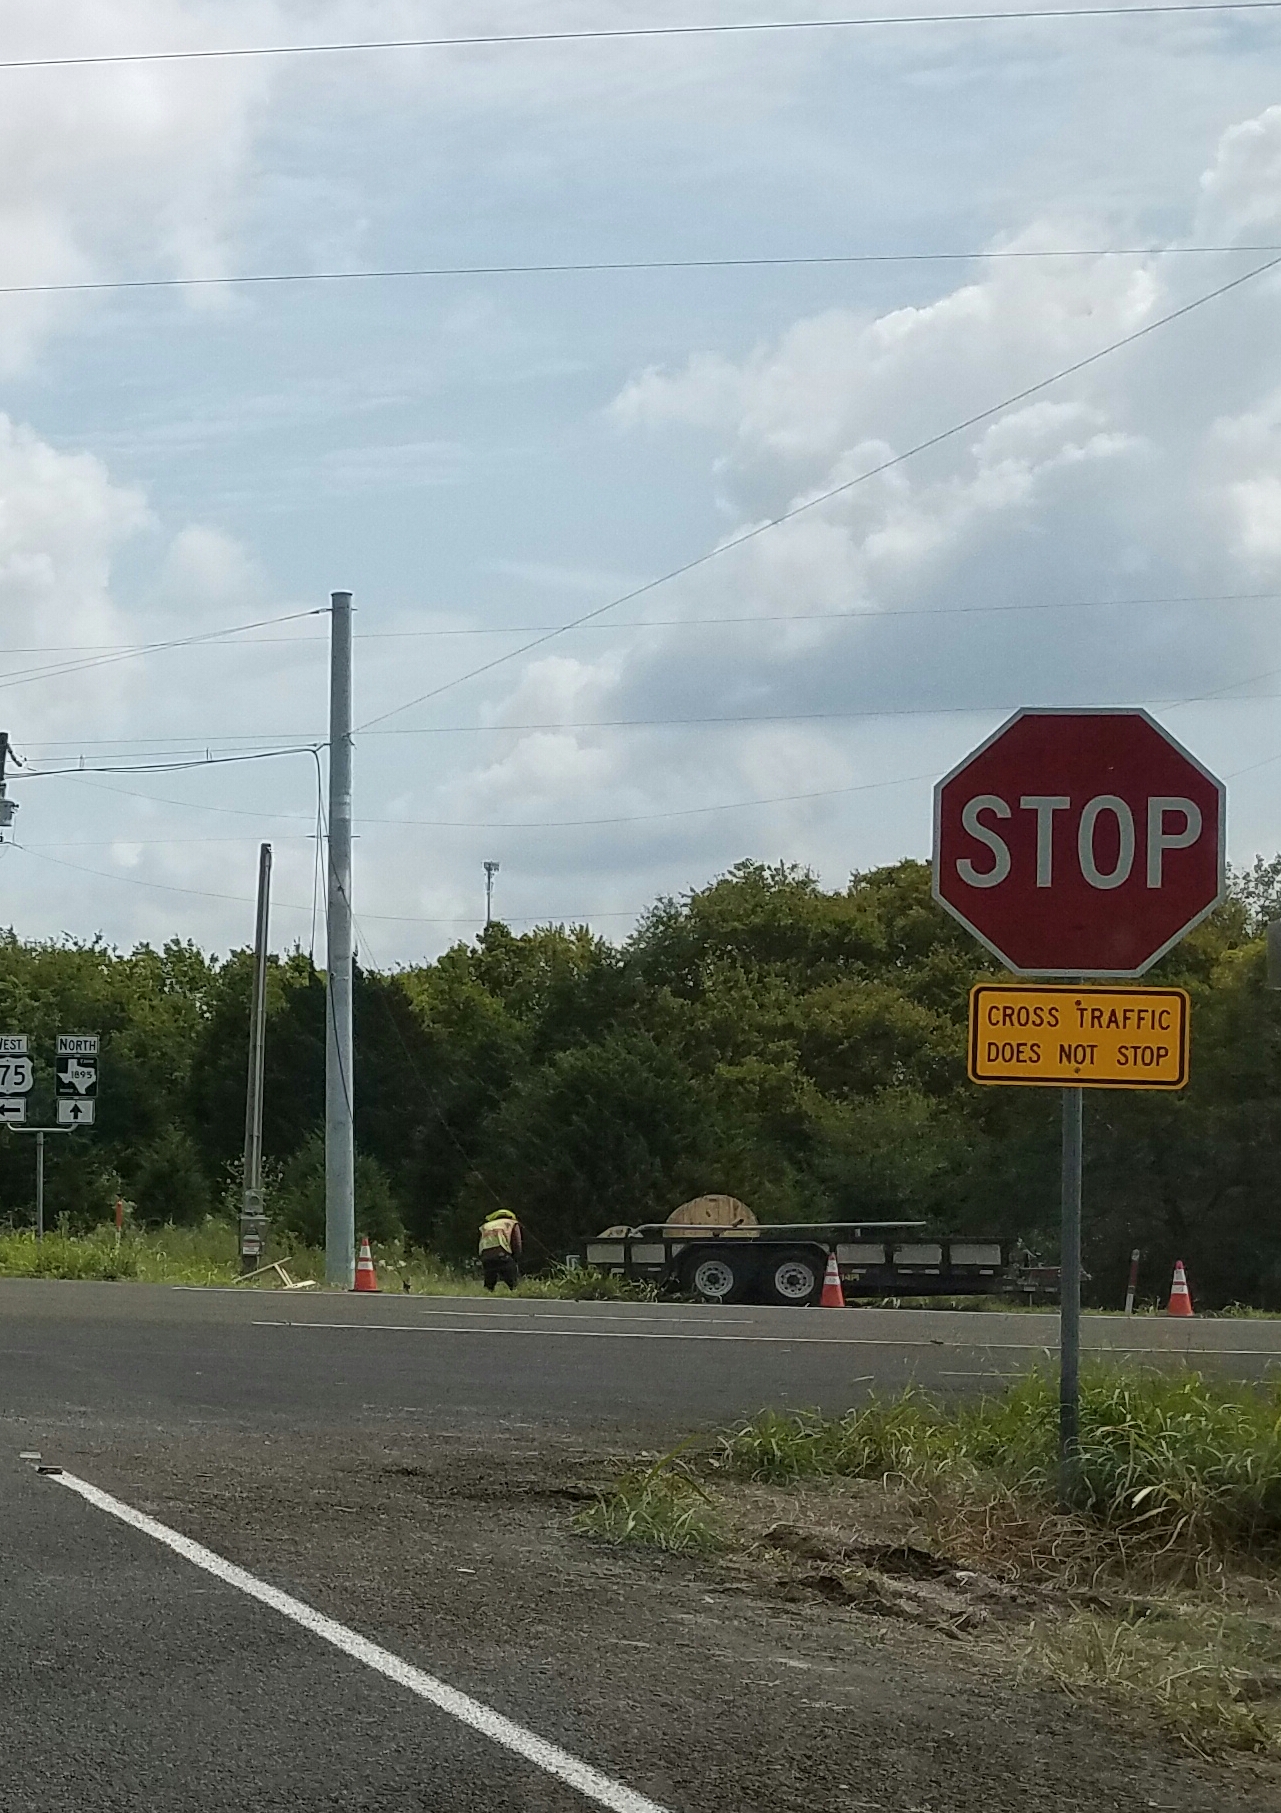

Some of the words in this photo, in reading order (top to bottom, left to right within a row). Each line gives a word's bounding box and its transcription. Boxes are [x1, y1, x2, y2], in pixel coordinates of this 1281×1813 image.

[956, 795, 1202, 889] STOP
[987, 1005, 1060, 1027] CROSS
[1076, 1008, 1171, 1030] TRAFFIC
[59, 1037, 96, 1051] NORTH
[987, 1043, 1041, 1063] DOES
[1058, 1045, 1098, 1066] NOT
[1116, 1046, 1169, 1067] STOP
[71, 1070, 93, 1079] 1895
